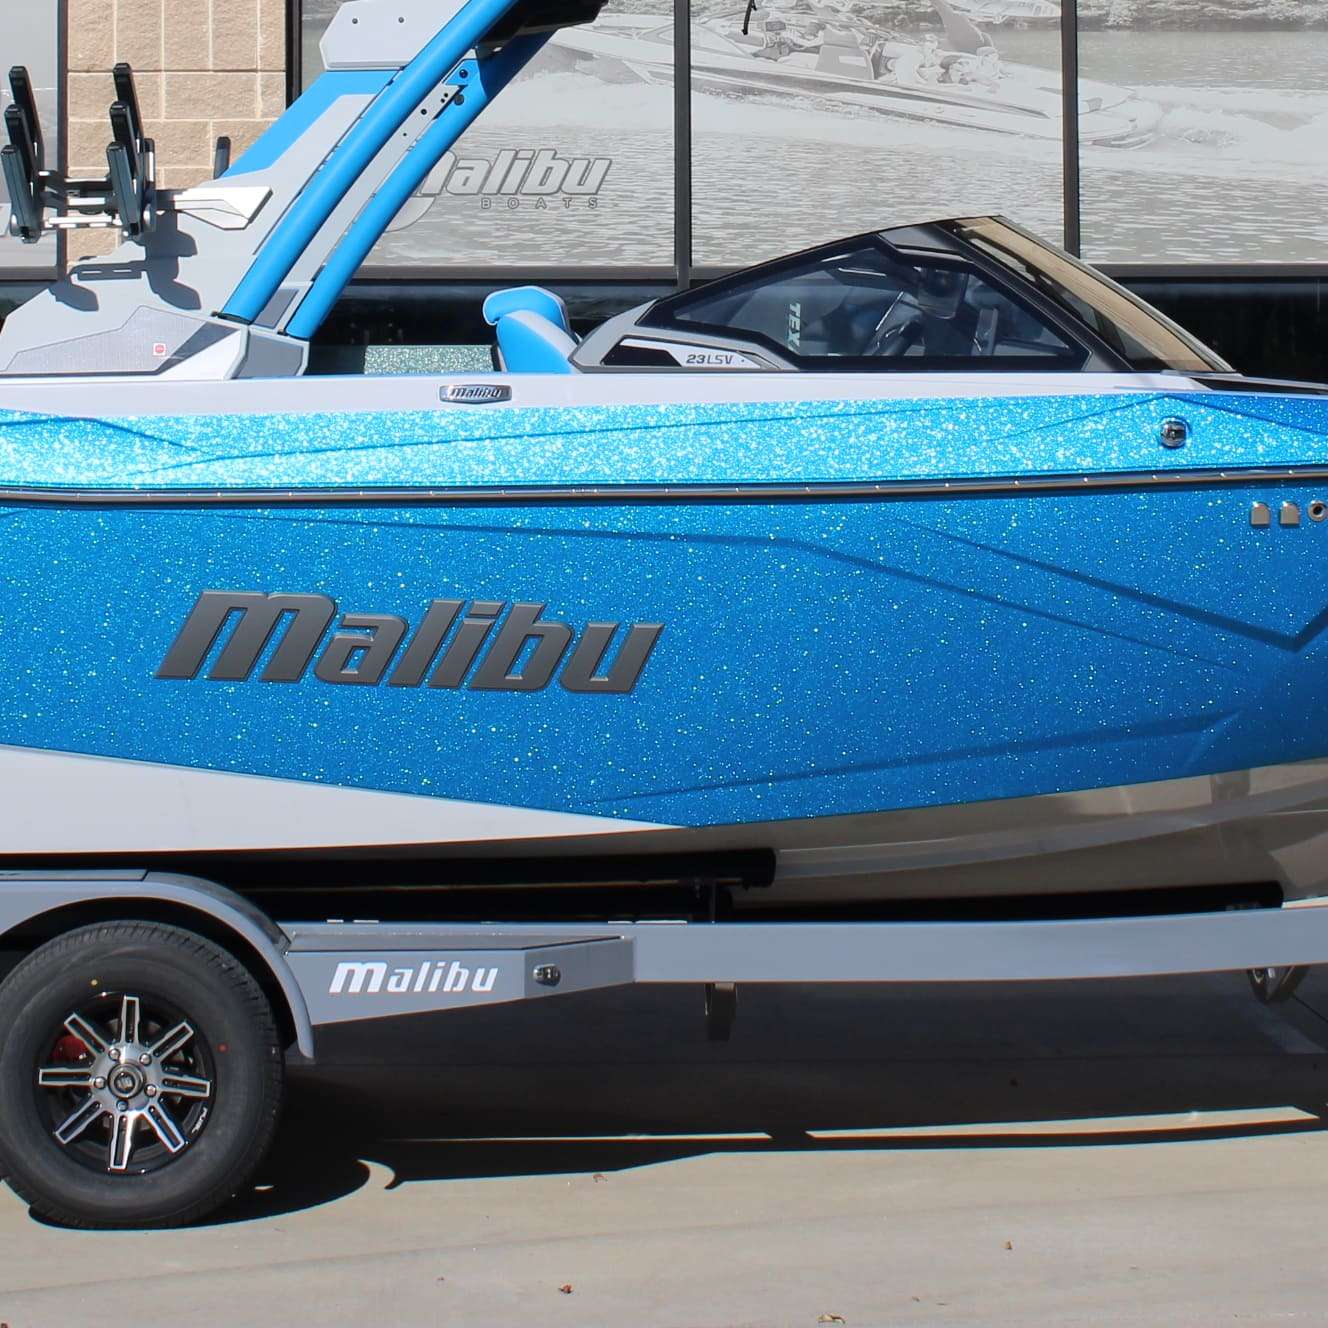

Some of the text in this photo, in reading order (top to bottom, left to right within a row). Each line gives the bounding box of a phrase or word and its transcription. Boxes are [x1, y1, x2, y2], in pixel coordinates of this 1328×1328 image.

[480, 196, 599, 209] BOATS
[153, 589, 664, 694] Malibu
[328, 960, 499, 993] Malibu
